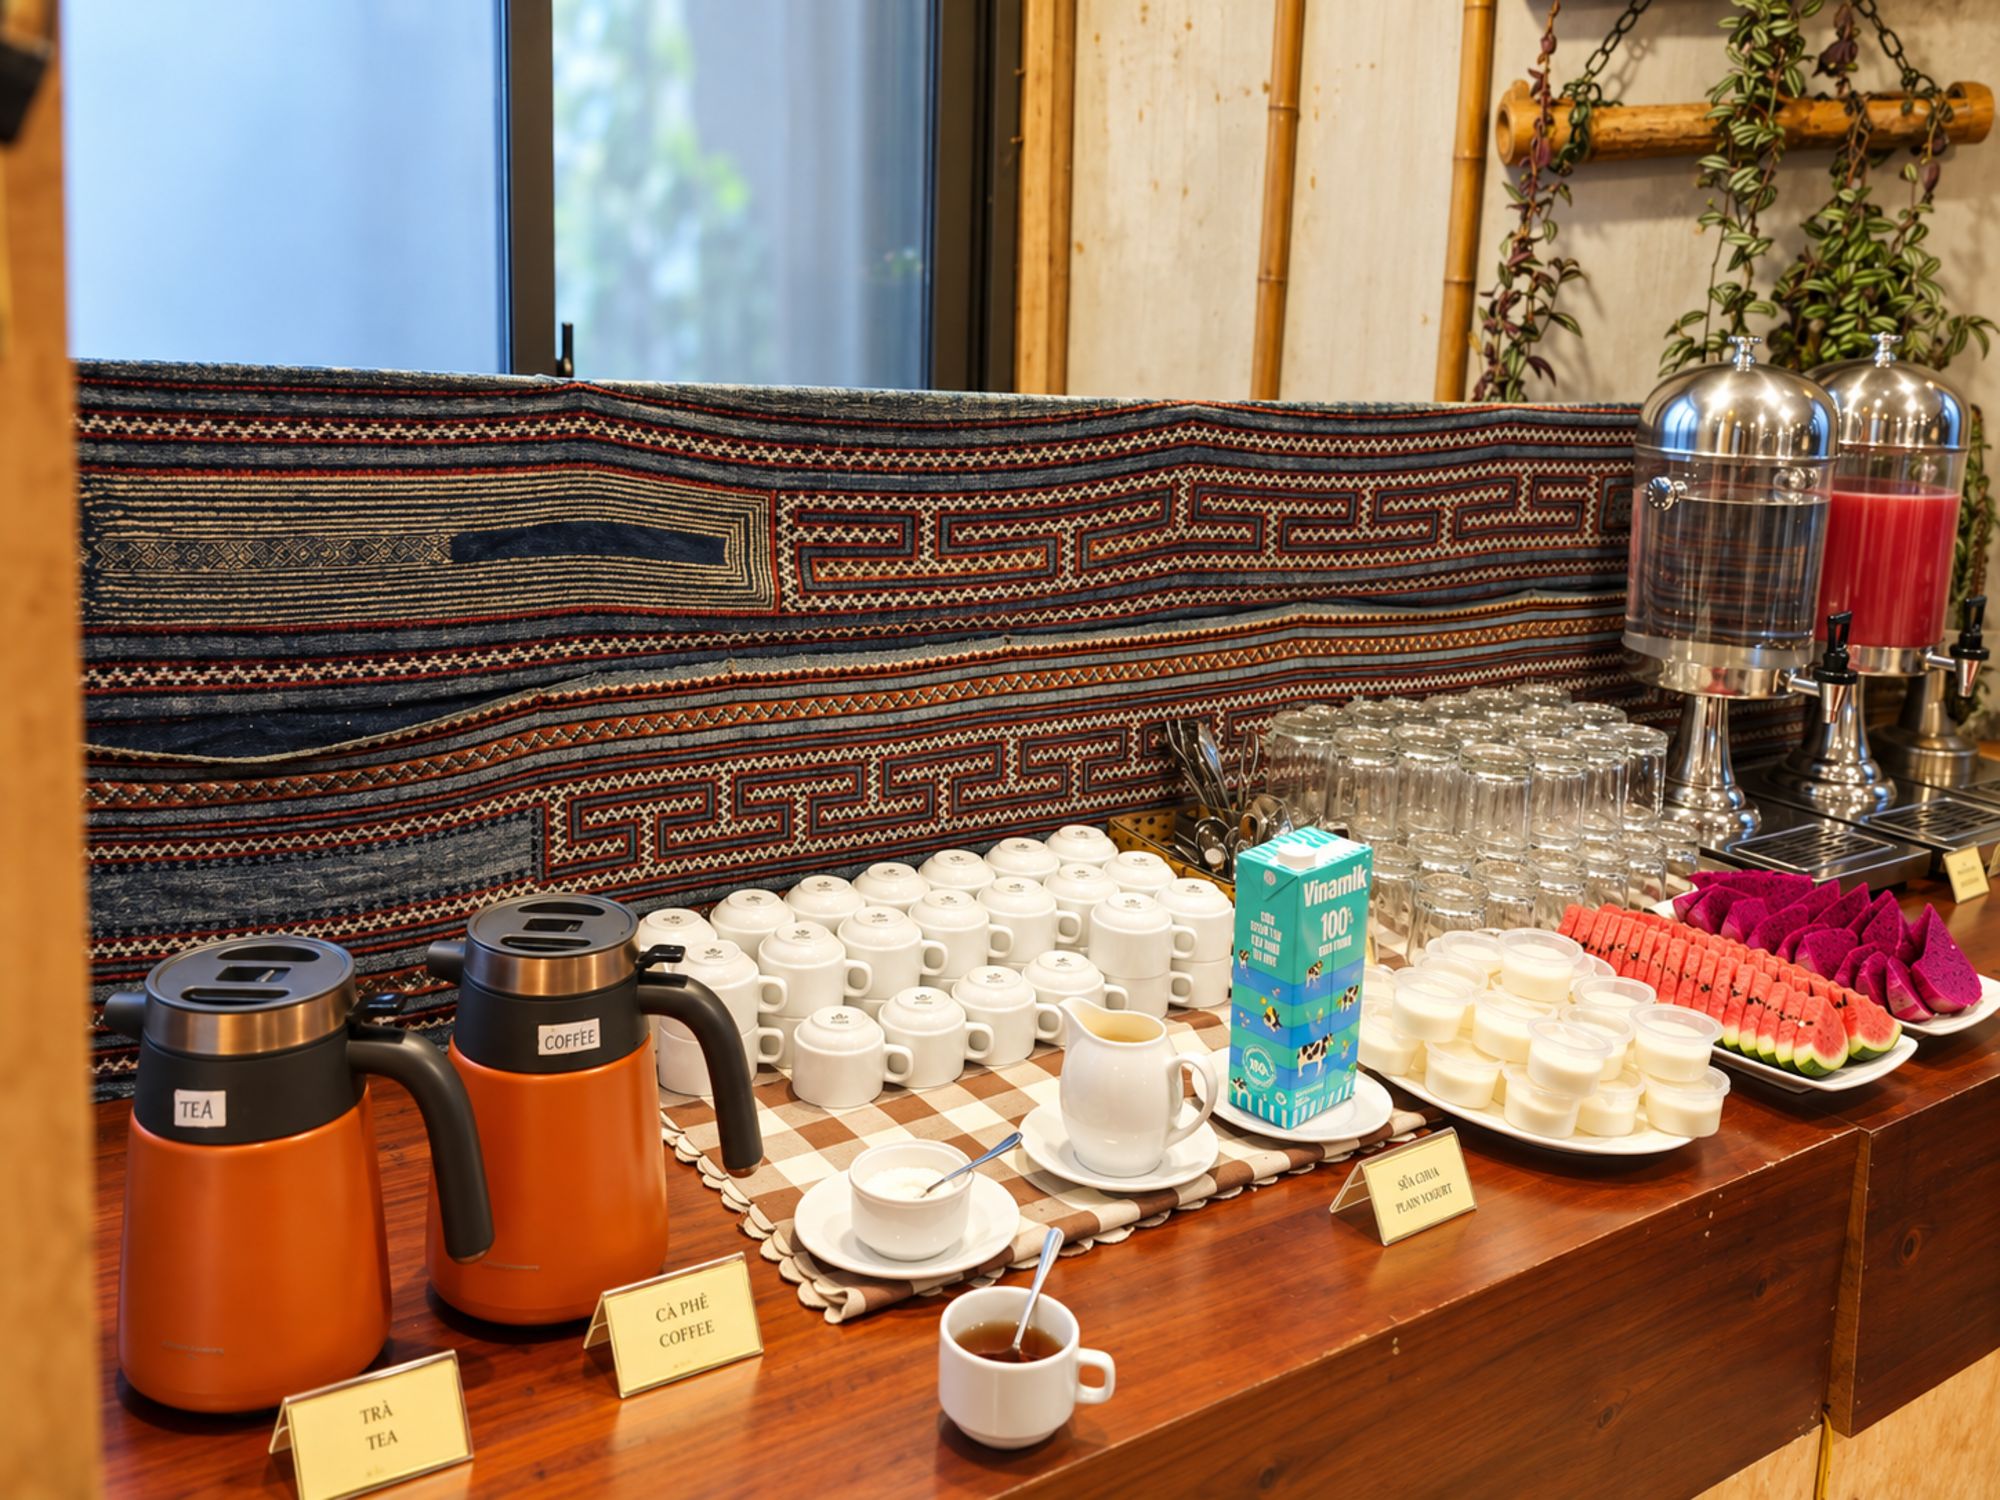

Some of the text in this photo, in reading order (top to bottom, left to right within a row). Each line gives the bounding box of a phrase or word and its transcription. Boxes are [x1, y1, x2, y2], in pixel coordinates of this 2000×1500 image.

[545, 1029, 595, 1050] COFFEE
[180, 1099, 213, 1119] TEA
[1395, 1183, 1453, 1214] PLAIN YOGURT
[655, 1292, 709, 1323] CÀ PHÊ
[659, 1319, 715, 1348] COFFEE
[360, 1400, 394, 1425] TRÀ
[365, 1429, 398, 1451] TEA
